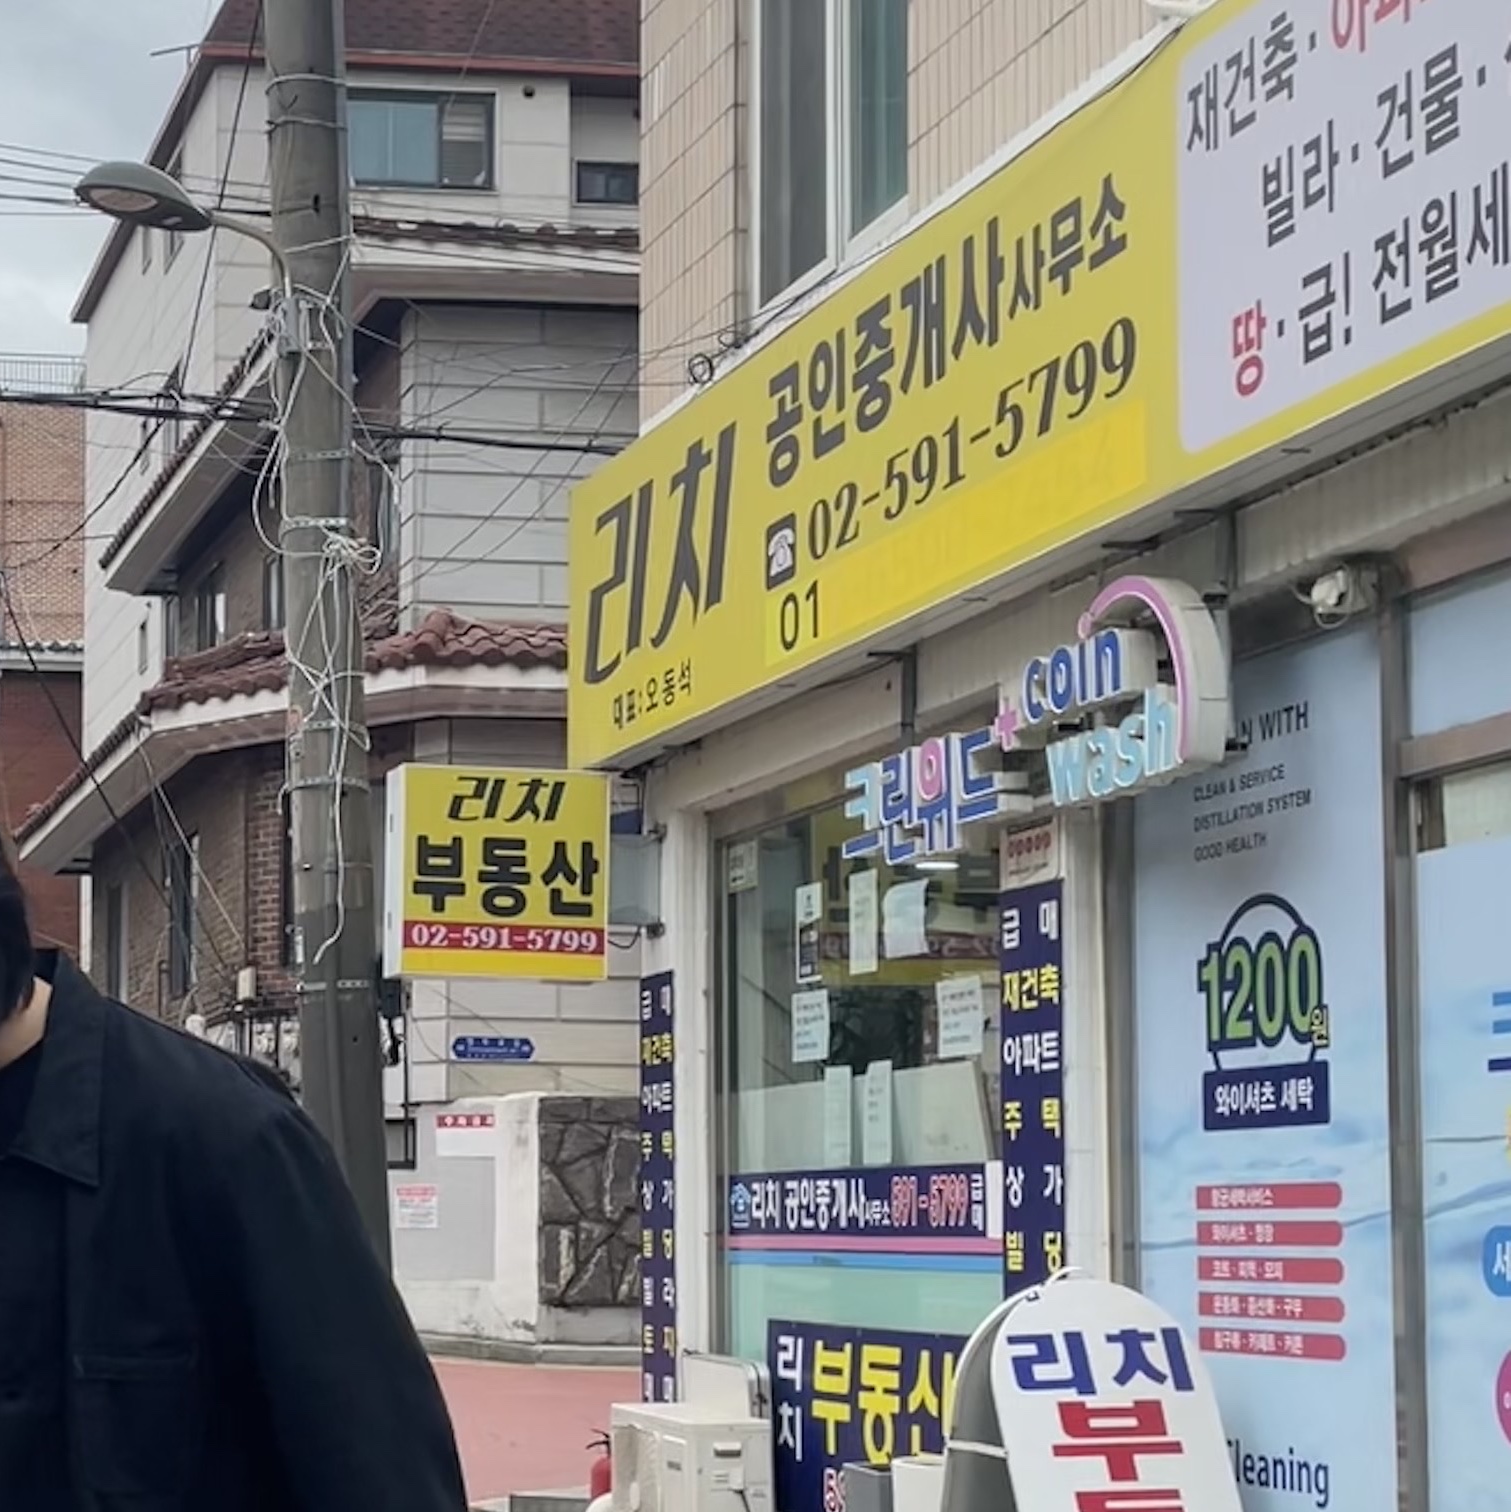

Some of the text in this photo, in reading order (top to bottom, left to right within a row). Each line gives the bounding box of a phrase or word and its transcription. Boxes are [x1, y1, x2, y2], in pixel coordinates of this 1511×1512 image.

[808, 316, 1137, 560] 02-591-5799
[584, 421, 737, 684] 리치
[780, 580, 819, 651] 01
[1022, 629, 1122, 724] coin
[1046, 686, 1178, 806] wash
[1259, 700, 1308, 741] WITH
[448, 776, 566, 823] 리치
[1194, 778, 1226, 802] CLEAN
[1239, 762, 1285, 791] SERVICE
[1194, 788, 1311, 833] DISTILLATION SYSTEM
[413, 834, 600, 918] 부동산
[412, 924, 598, 952] 02-591-5799
[1001, 963, 1060, 1012] 재건축
[1002, 1030, 1060, 1075] 아파트
[751, 1179, 781, 1229] 리치
[891, 1174, 970, 1228] 591-5799
[1007, 1327, 1195, 1395] 리치
[777, 1335, 803, 1462] 리치
[1228, 1438, 1329, 1509] leaning
